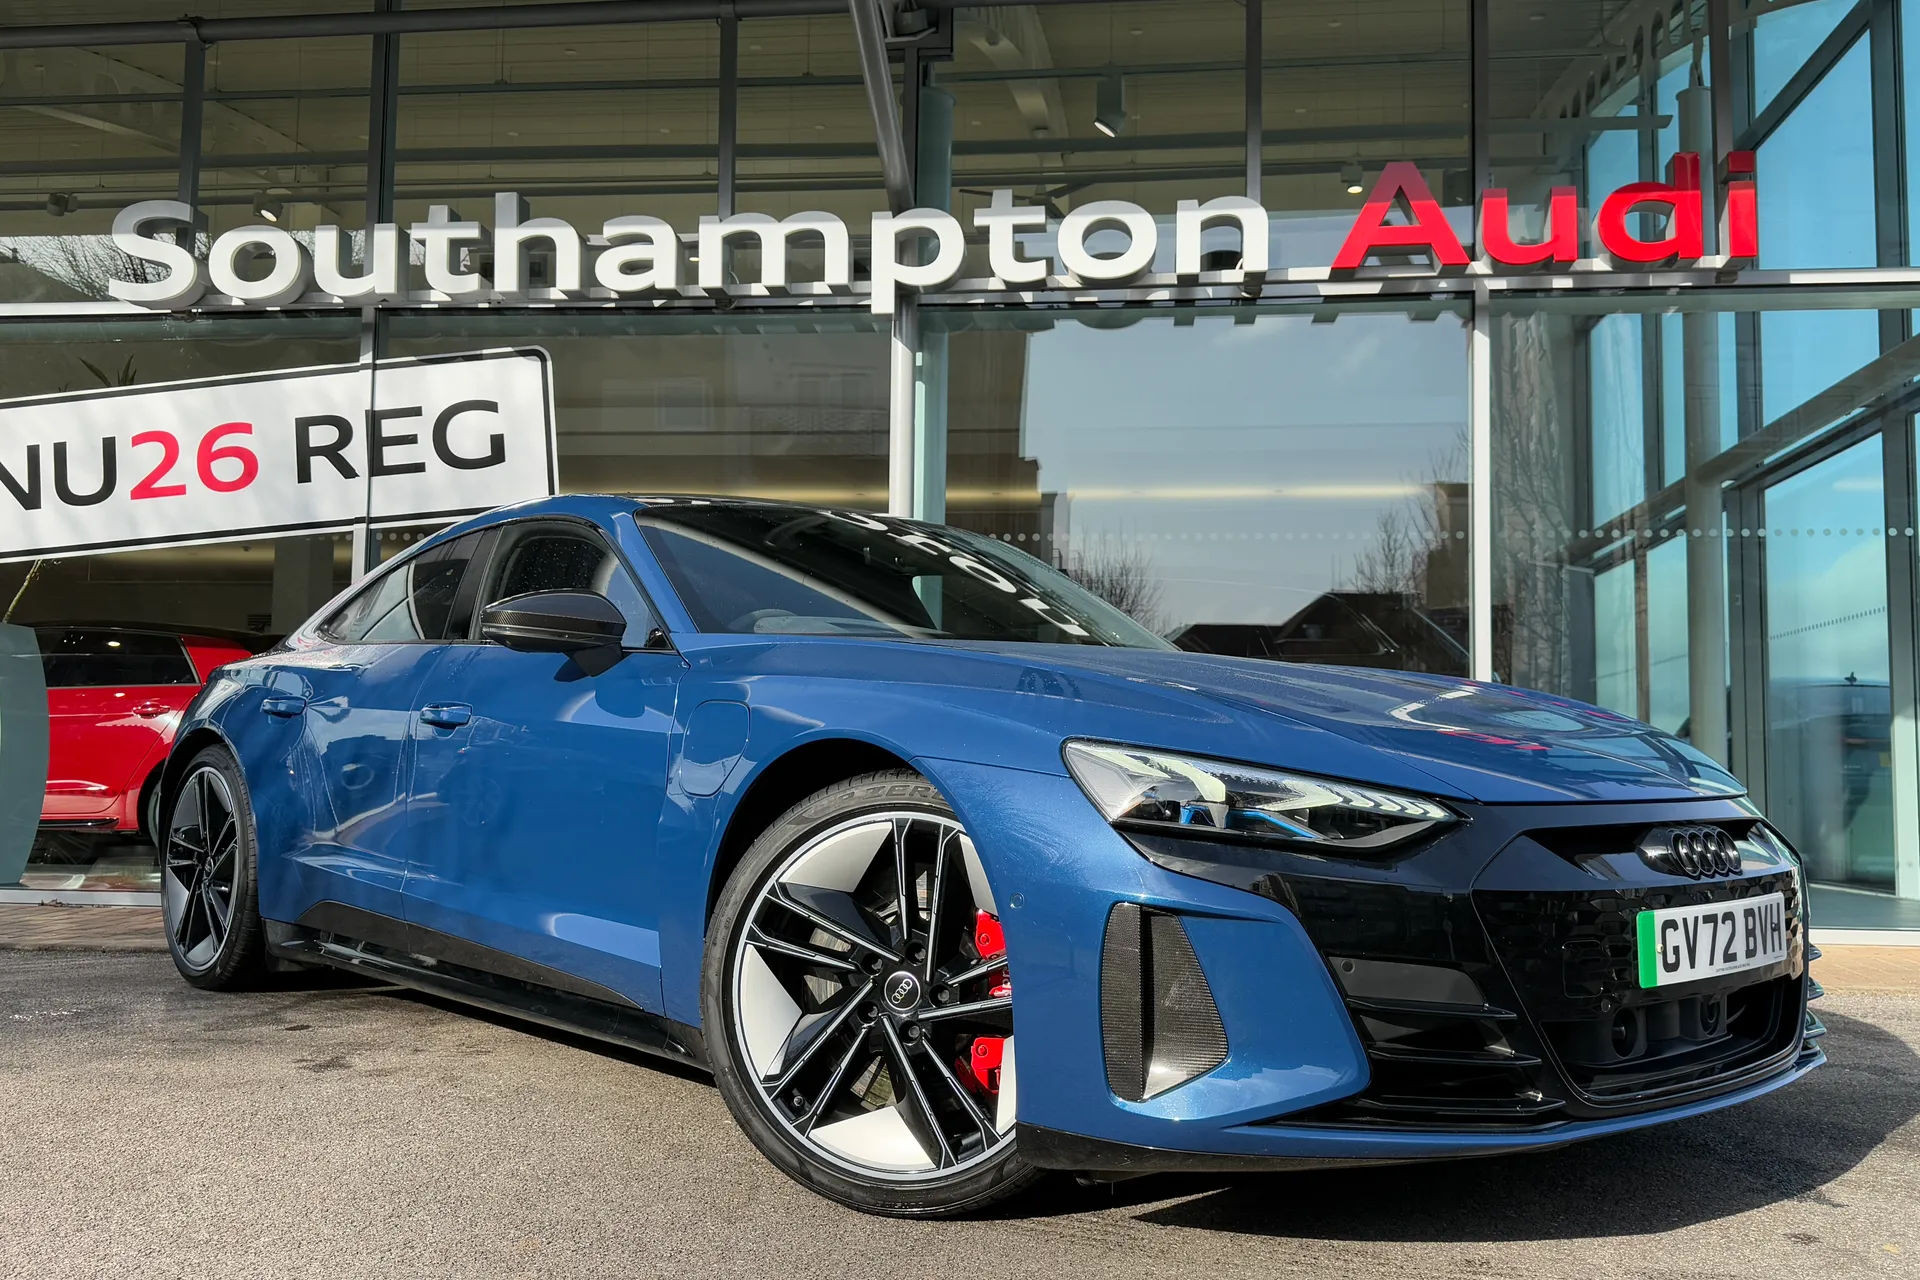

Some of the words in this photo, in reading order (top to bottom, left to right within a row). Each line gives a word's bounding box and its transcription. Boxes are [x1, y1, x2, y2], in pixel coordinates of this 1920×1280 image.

[109, 188, 1269, 316] Southampton
[1331, 151, 1758, 270] Audi
[294, 399, 507, 484] REG
[861, 783, 945, 800] ZER
[1661, 910, 1738, 974] GV72
[1743, 902, 1783, 960] BVH
